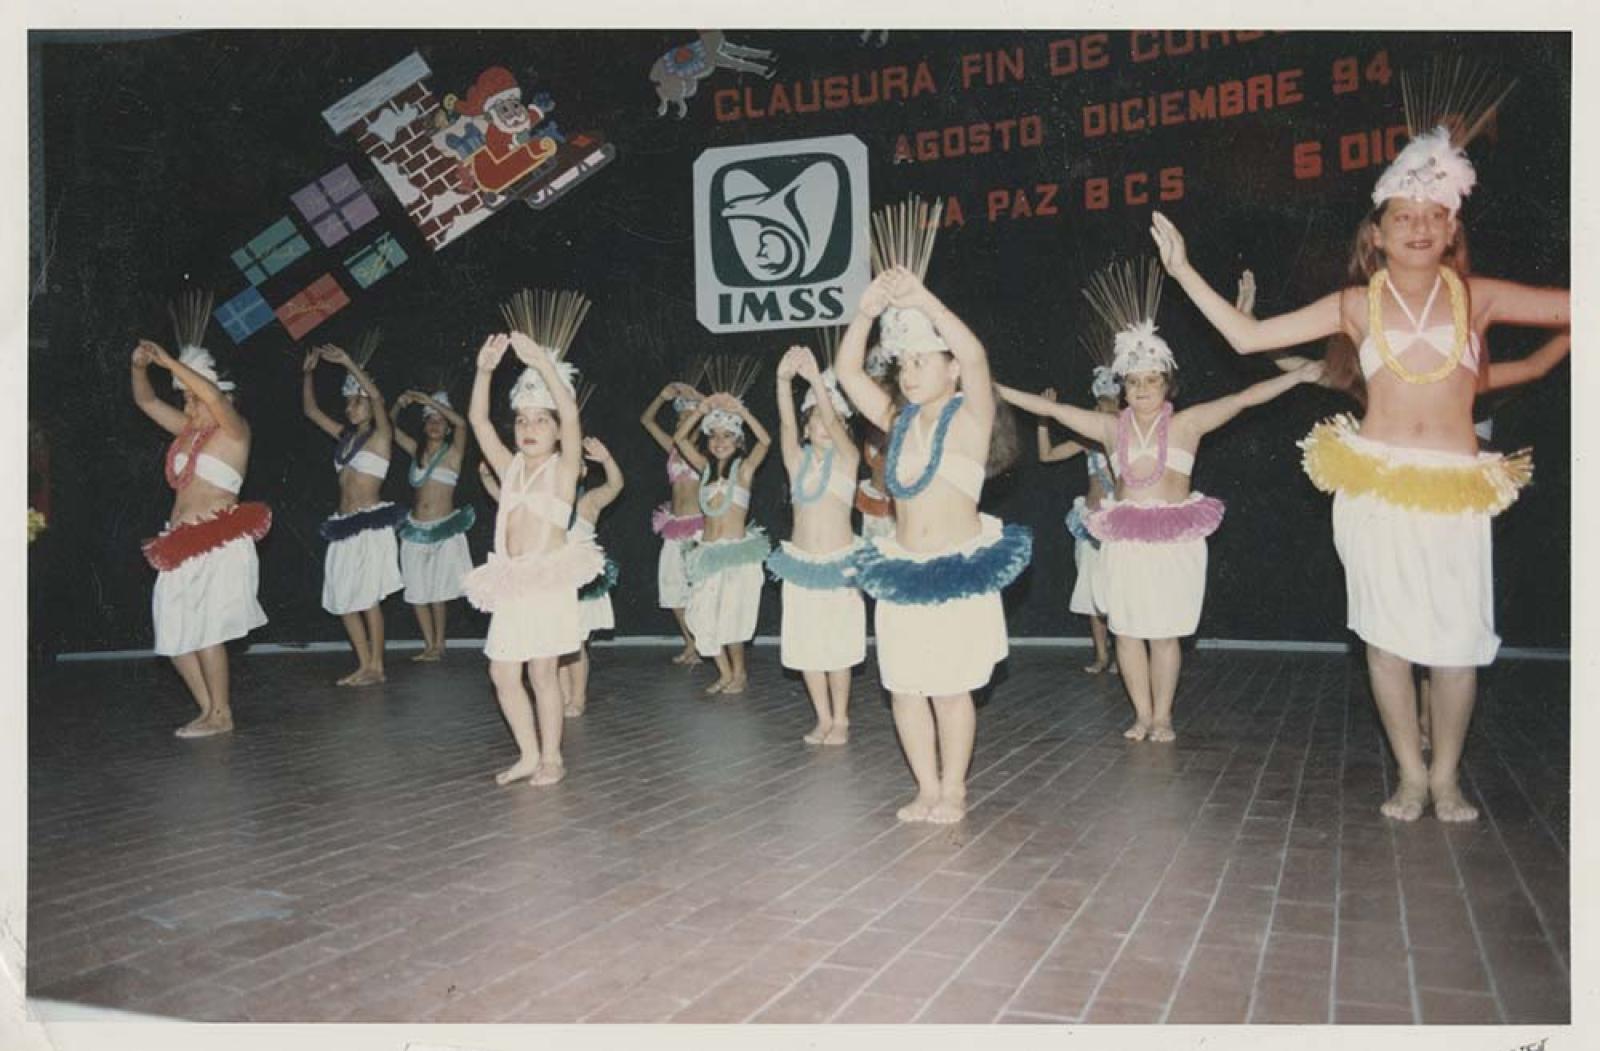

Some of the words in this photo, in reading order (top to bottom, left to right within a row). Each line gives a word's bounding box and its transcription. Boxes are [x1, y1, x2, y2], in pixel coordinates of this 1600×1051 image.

[714, 61, 936, 122] CLAUSURA
[962, 47, 1025, 88] FIN
[1049, 33, 1110, 73] DE
[895, 114, 1043, 164] AGOSTO
[1083, 69, 1304, 138] DICIEMBRE
[1332, 50, 1392, 95] 94
[988, 183, 1059, 222] PAZ
[718, 286, 845, 325] IMSS
